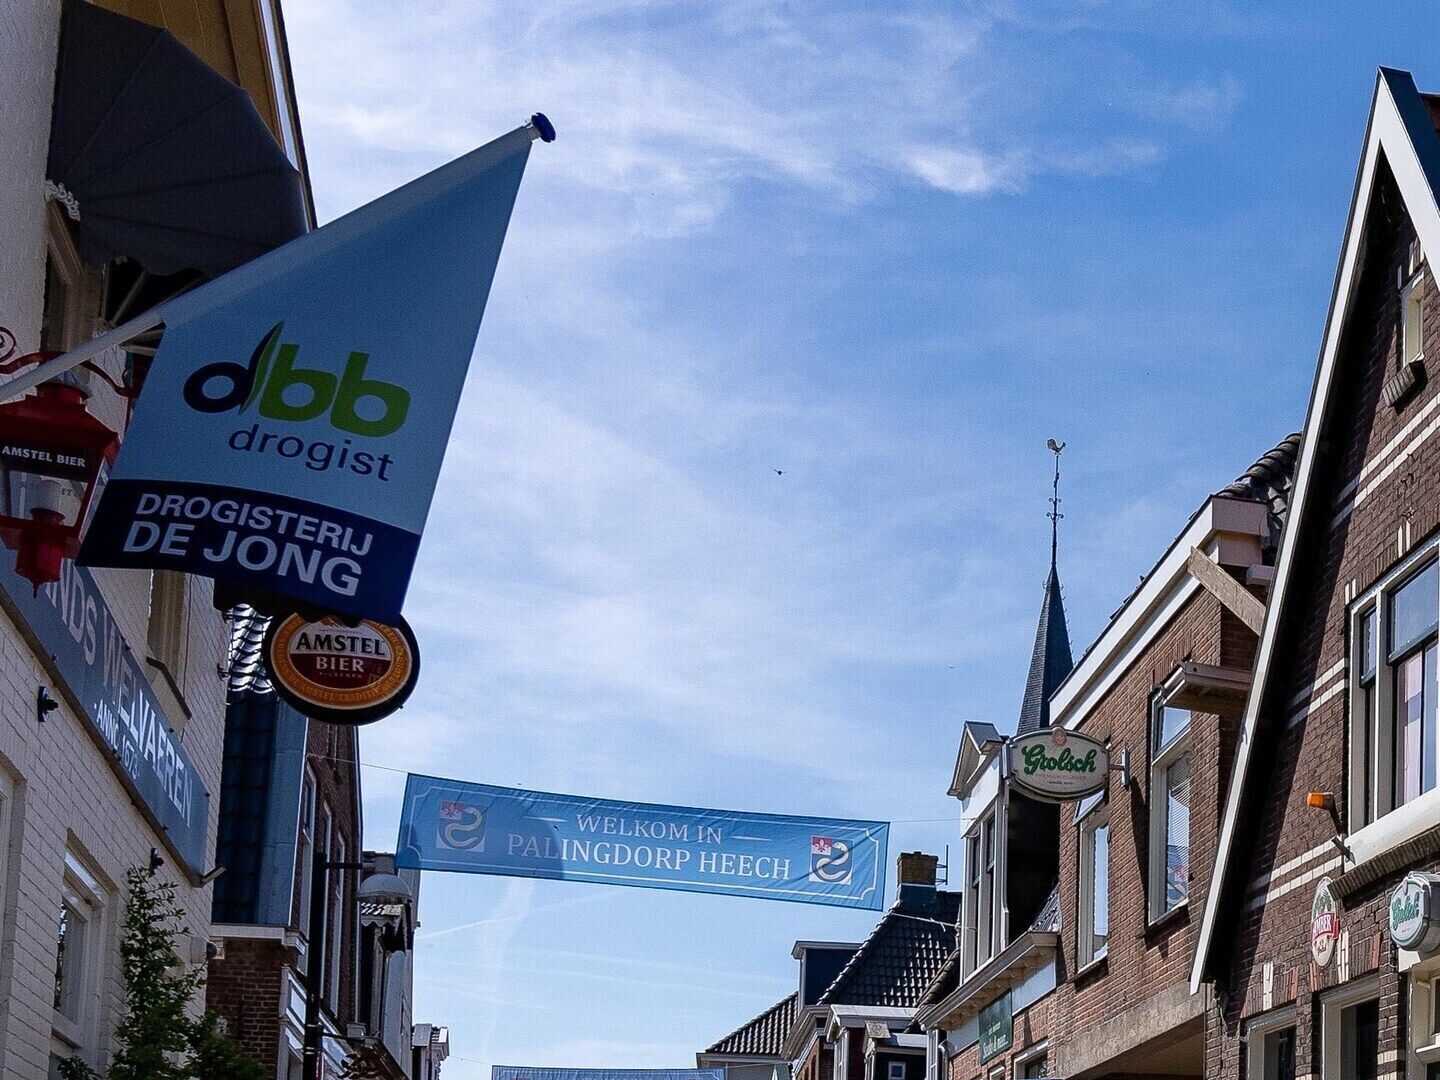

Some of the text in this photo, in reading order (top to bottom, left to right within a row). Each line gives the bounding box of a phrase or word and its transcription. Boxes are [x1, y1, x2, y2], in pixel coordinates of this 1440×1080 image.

[183, 320, 411, 438] dbb
[2, 446, 86, 468] AMSTEL BIER
[228, 424, 394, 482] drogist
[136, 493, 373, 557] DROGISTERIJ
[123, 521, 362, 597] DE JONG
[296, 632, 385, 656] AMSTEL
[316, 656, 364, 673] BIER
[1021, 744, 1097, 775] Grolsch
[576, 814, 723, 844] WELKOM IN
[507, 834, 790, 880] PALINGDORP HEECH
